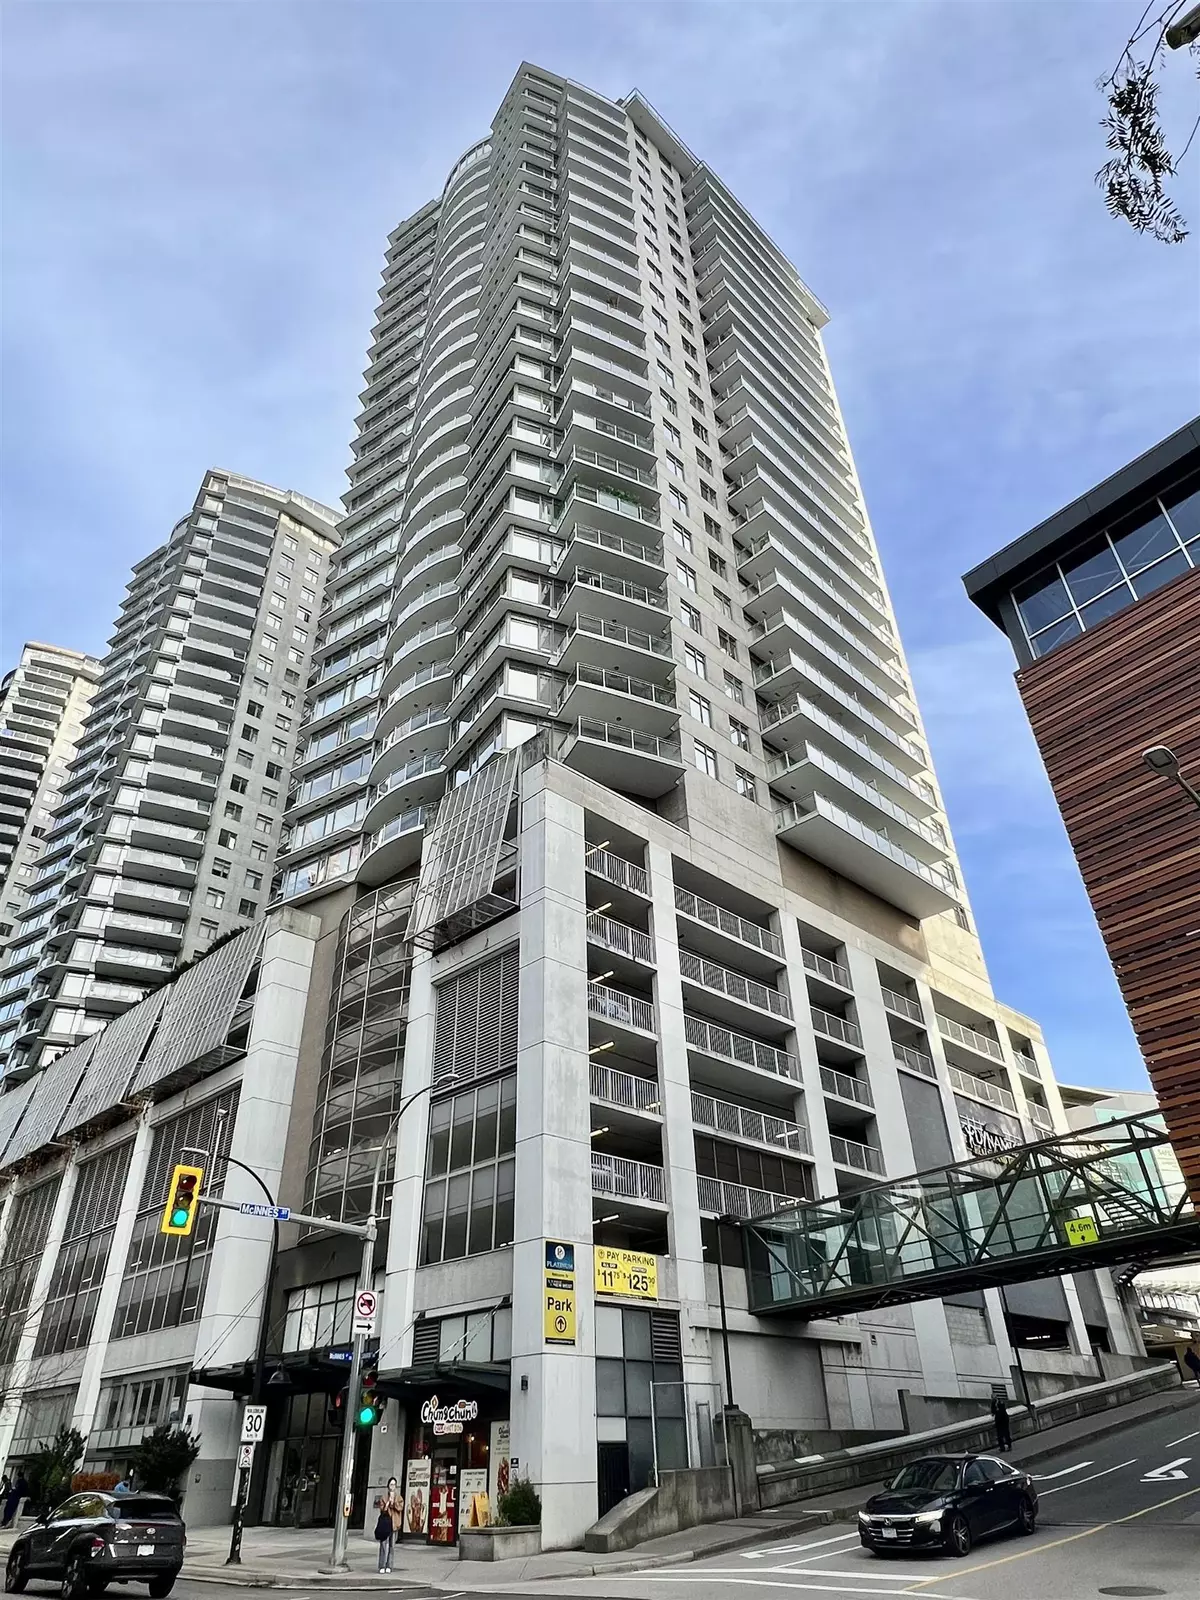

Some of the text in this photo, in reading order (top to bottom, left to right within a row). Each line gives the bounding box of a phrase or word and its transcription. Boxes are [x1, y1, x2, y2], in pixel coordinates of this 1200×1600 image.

[241, 1203, 279, 1218] McINNES
[1069, 1222, 1092, 1233] 4.6m
[606, 1250, 655, 1266] PAY PARKING
[547, 1296, 573, 1313] Park
[245, 1414, 262, 1432] 30
